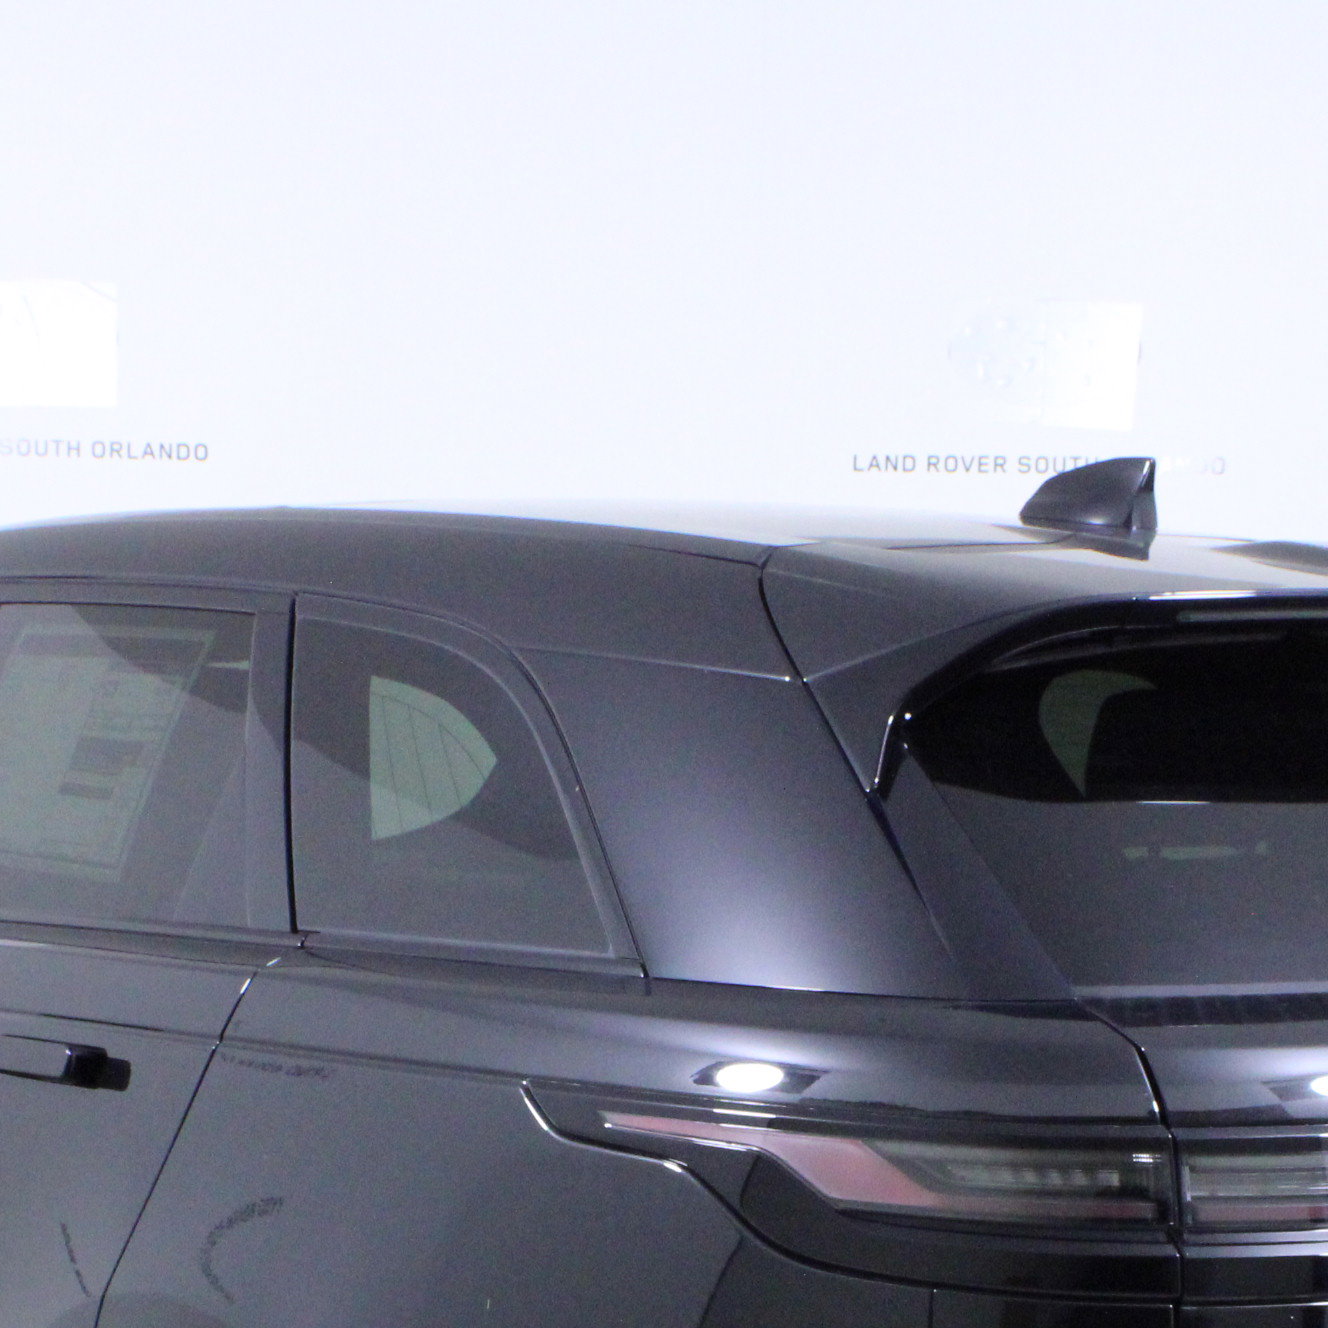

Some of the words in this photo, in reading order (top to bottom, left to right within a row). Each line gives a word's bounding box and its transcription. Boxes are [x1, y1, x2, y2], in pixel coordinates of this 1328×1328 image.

[0, 437, 82, 459] SOUTH
[91, 441, 209, 462] ORLANDO
[852, 454, 917, 473] LAND
[926, 454, 1008, 473] ROVER
